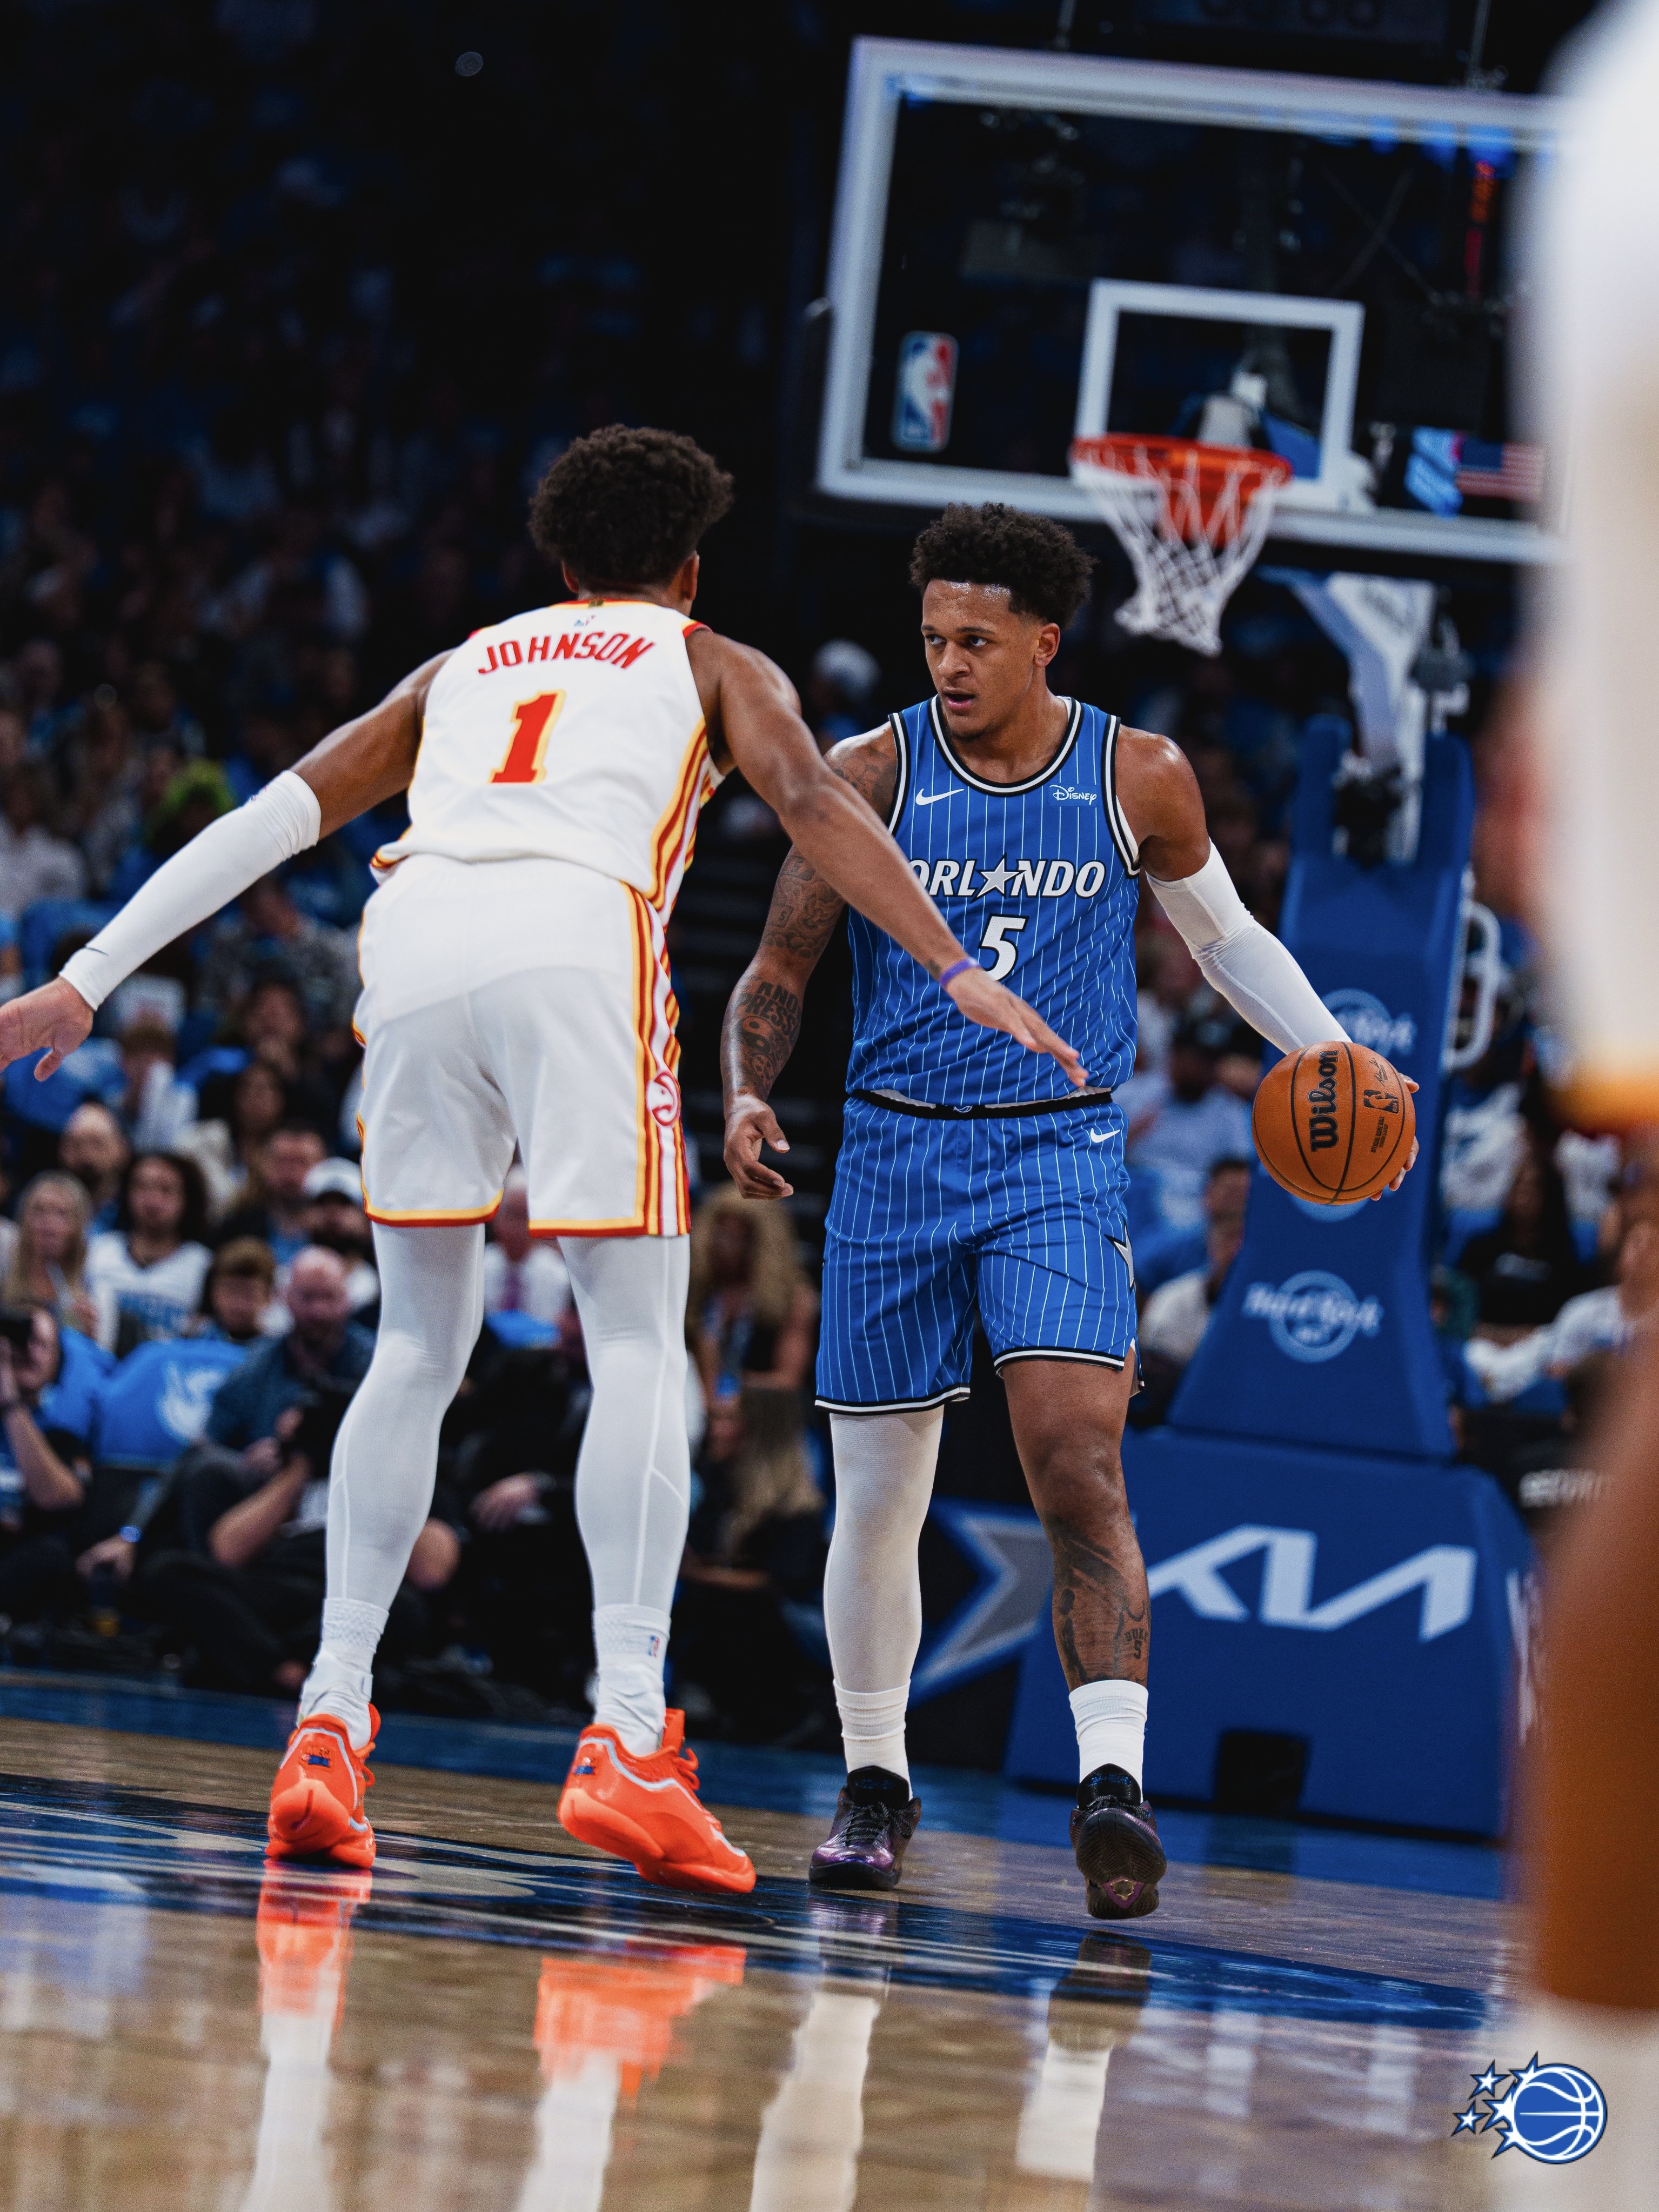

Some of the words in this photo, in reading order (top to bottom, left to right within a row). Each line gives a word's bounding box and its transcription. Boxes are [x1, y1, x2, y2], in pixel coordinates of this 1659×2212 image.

[478, 631, 656, 675] JOHNSON
[488, 689, 566, 784] 1
[1049, 785, 1098, 806] Disney
[980, 915, 1028, 981] 5
[1308, 1050, 1340, 1152] Wilson
